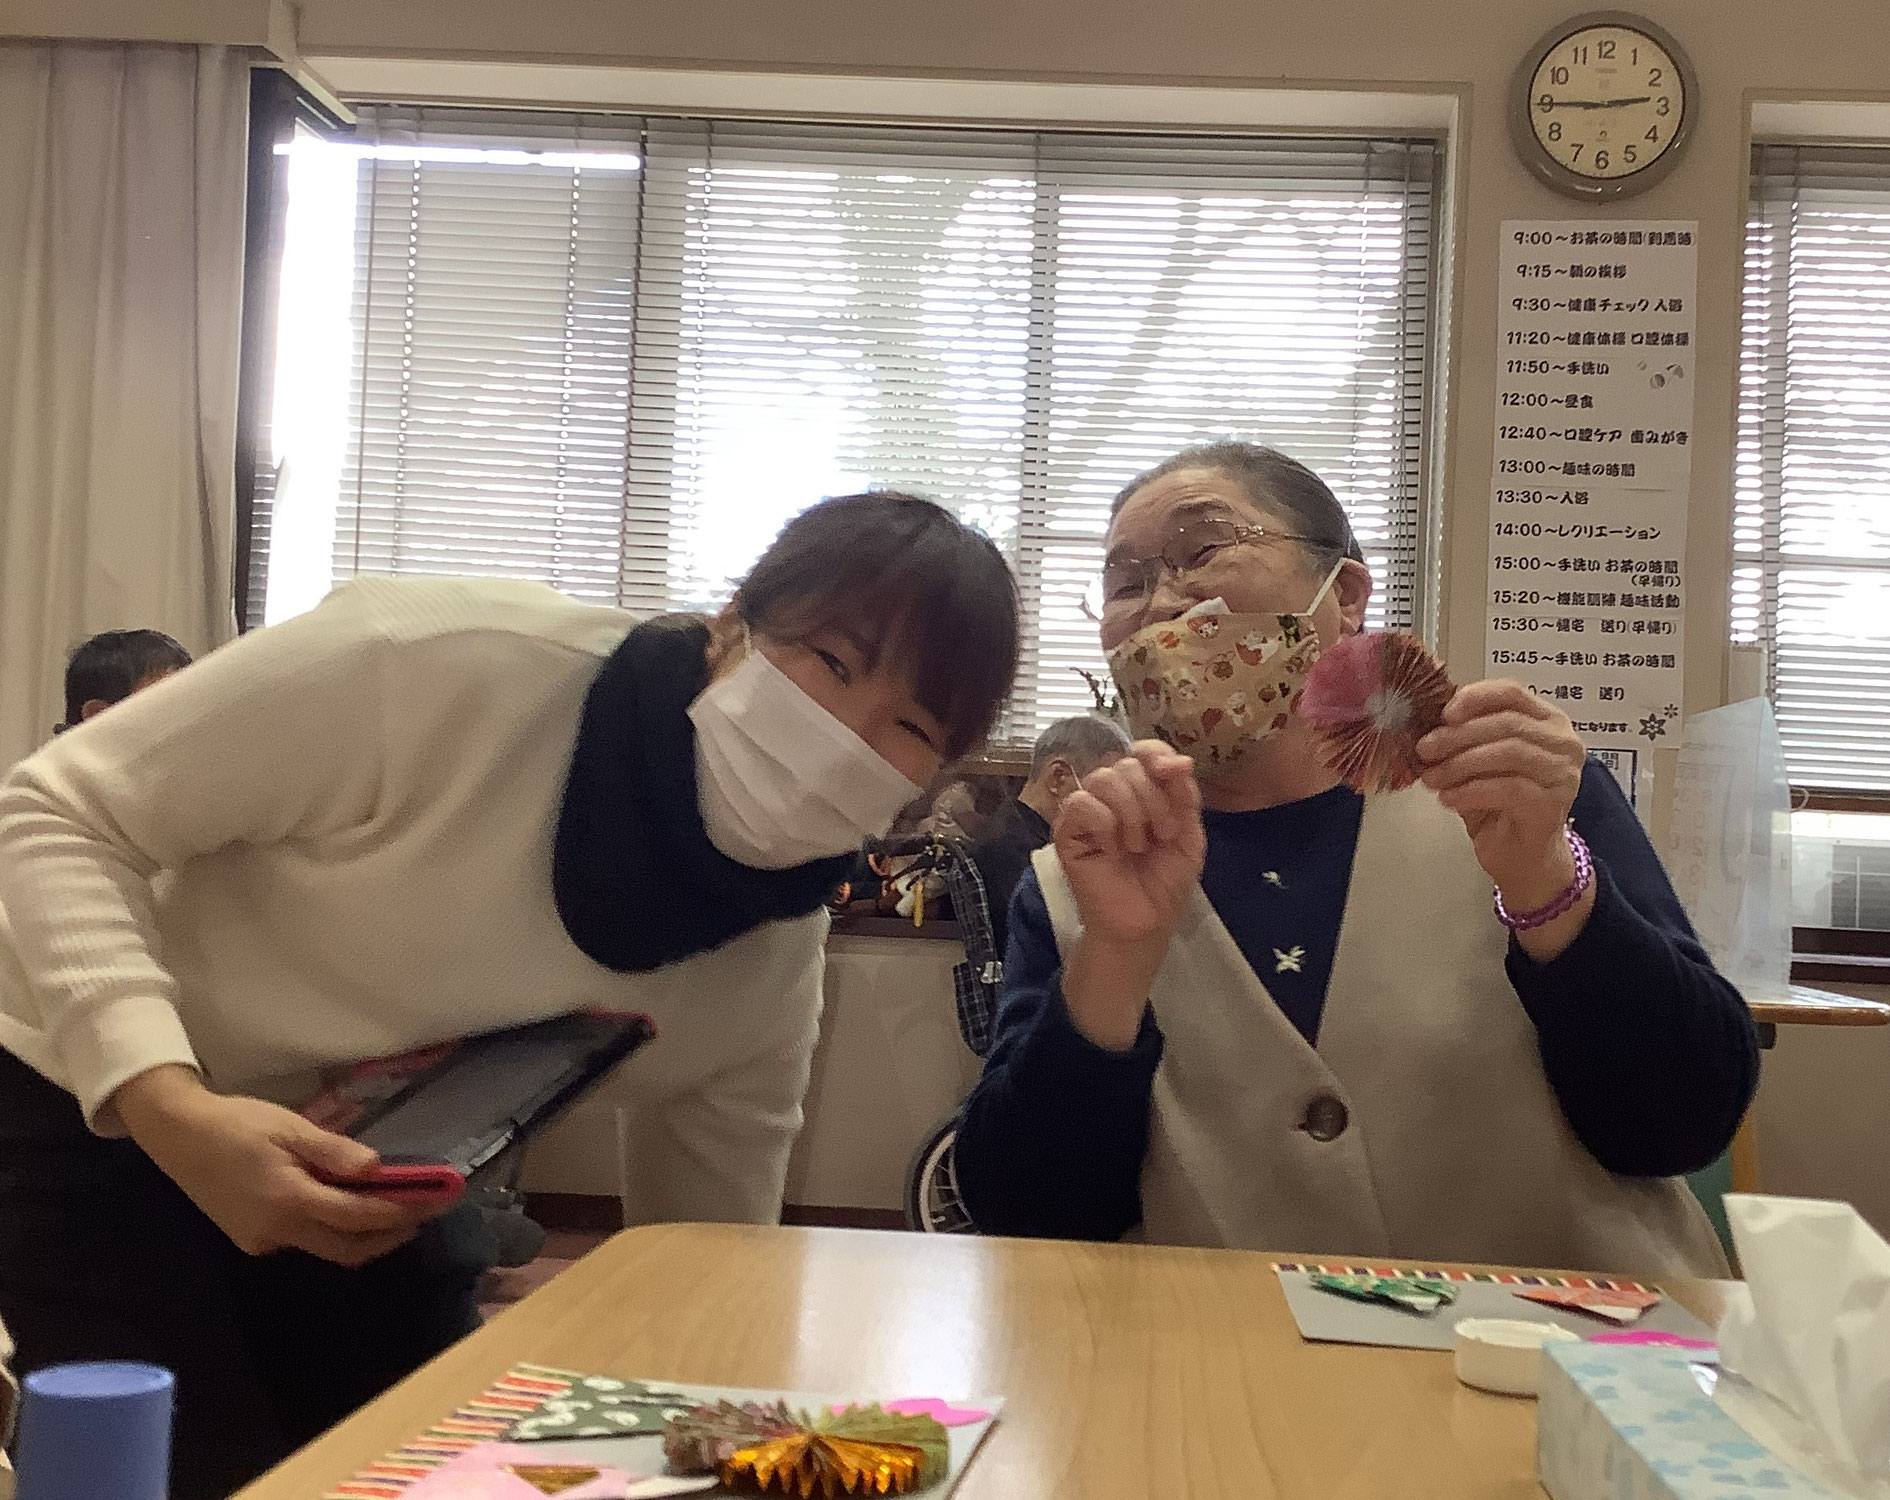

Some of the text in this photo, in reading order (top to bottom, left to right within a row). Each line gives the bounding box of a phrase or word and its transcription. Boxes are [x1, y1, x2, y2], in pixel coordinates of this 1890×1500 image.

[1572, 45, 1588, 66] 11
[1596, 40, 1617, 60] 12
[1631, 47, 1638, 66] 1
[1549, 65, 1570, 86] 10
[1647, 67, 1662, 88] 2
[1539, 93, 1553, 113] 9
[1655, 95, 1670, 118] 3
[1547, 121, 1563, 142] 8
[1643, 124, 1660, 144] 4
[1569, 142, 1585, 163] 7
[1594, 149, 1610, 171] 6
[1622, 144, 1638, 164] 5
[1653, 298, 1683, 313] 入浴
[1506, 359, 1610, 376] 11:50～手洗い
[1501, 392, 1594, 409] 12:00～昼食
[1630, 428, 1689, 446] 歯みがき
[1496, 489, 1590, 506] 13:30～入浴
[1494, 522, 1661, 541] 14:00～レクリエーション
[1494, 555, 1679, 576] 15:00～手洗い お茶の時間
[1492, 616, 1585, 633] 15:30～帰宅
[1491, 649, 1676, 669] 15:45～手洗い お茶の時間
